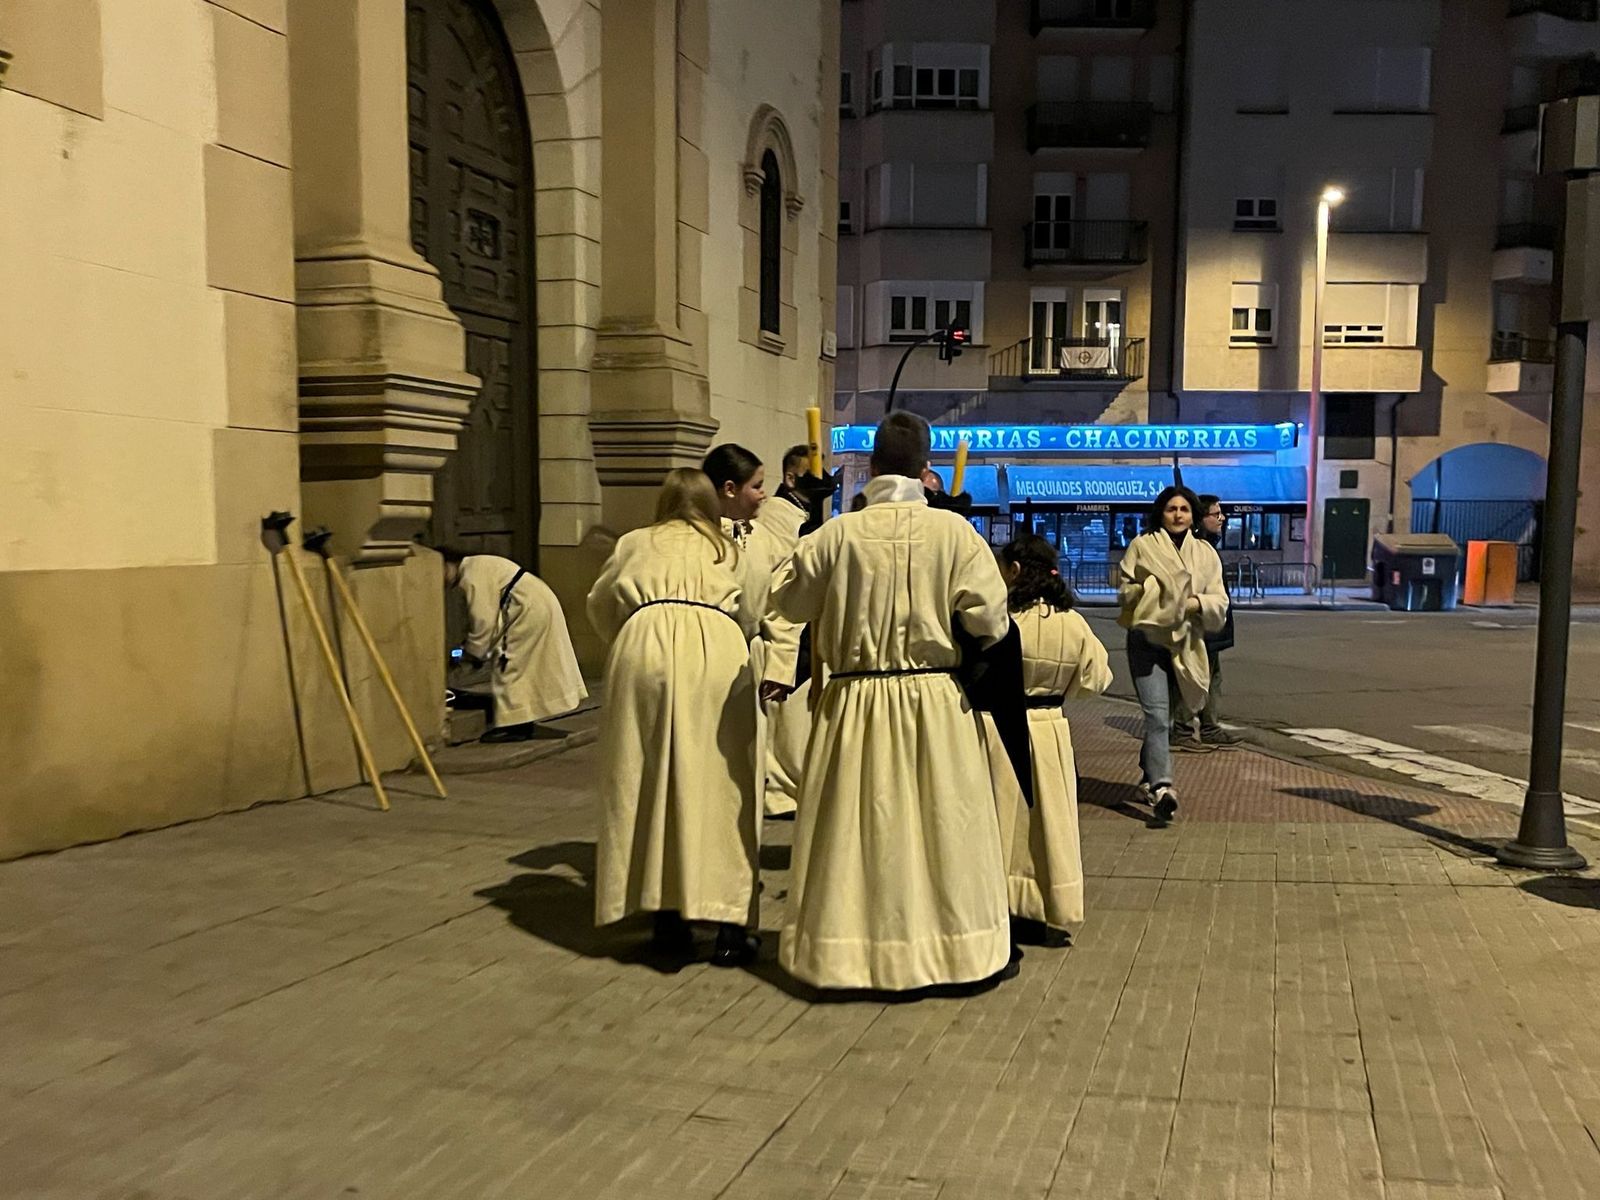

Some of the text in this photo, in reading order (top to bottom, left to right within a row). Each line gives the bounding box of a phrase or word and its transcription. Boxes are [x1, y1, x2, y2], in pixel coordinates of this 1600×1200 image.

[862, 430, 1041, 448] JNERIAS
[1066, 430, 1258, 448] CHACINERIAS
[1016, 480, 1082, 496] MELQUIADES
[1086, 480, 1147, 498] RODRIGUEZ,
